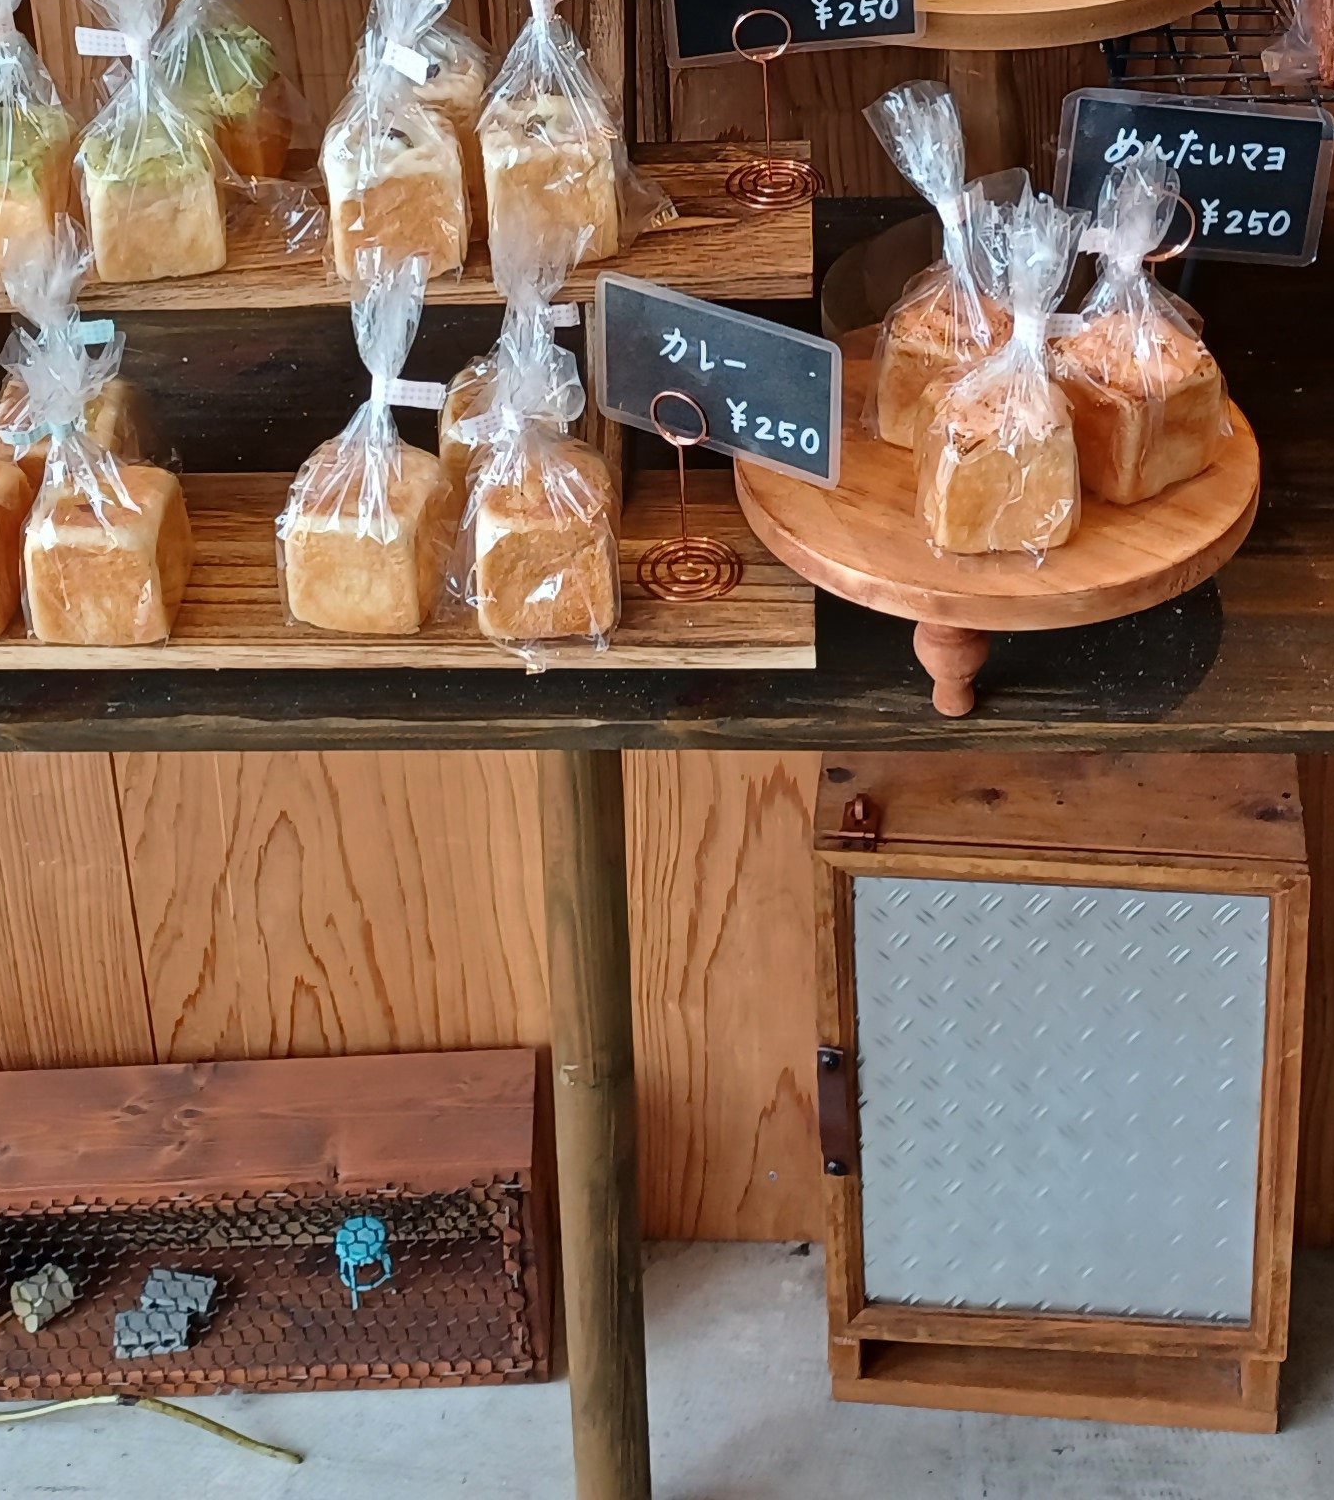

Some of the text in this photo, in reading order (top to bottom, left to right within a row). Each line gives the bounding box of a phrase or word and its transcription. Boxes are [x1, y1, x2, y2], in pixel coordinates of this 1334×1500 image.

[1103, 127, 1287, 172] めんたいマヨ
[1200, 198, 1292, 237] ¥250
[659, 327, 748, 372] カレー
[725, 397, 821, 455] ¥250
